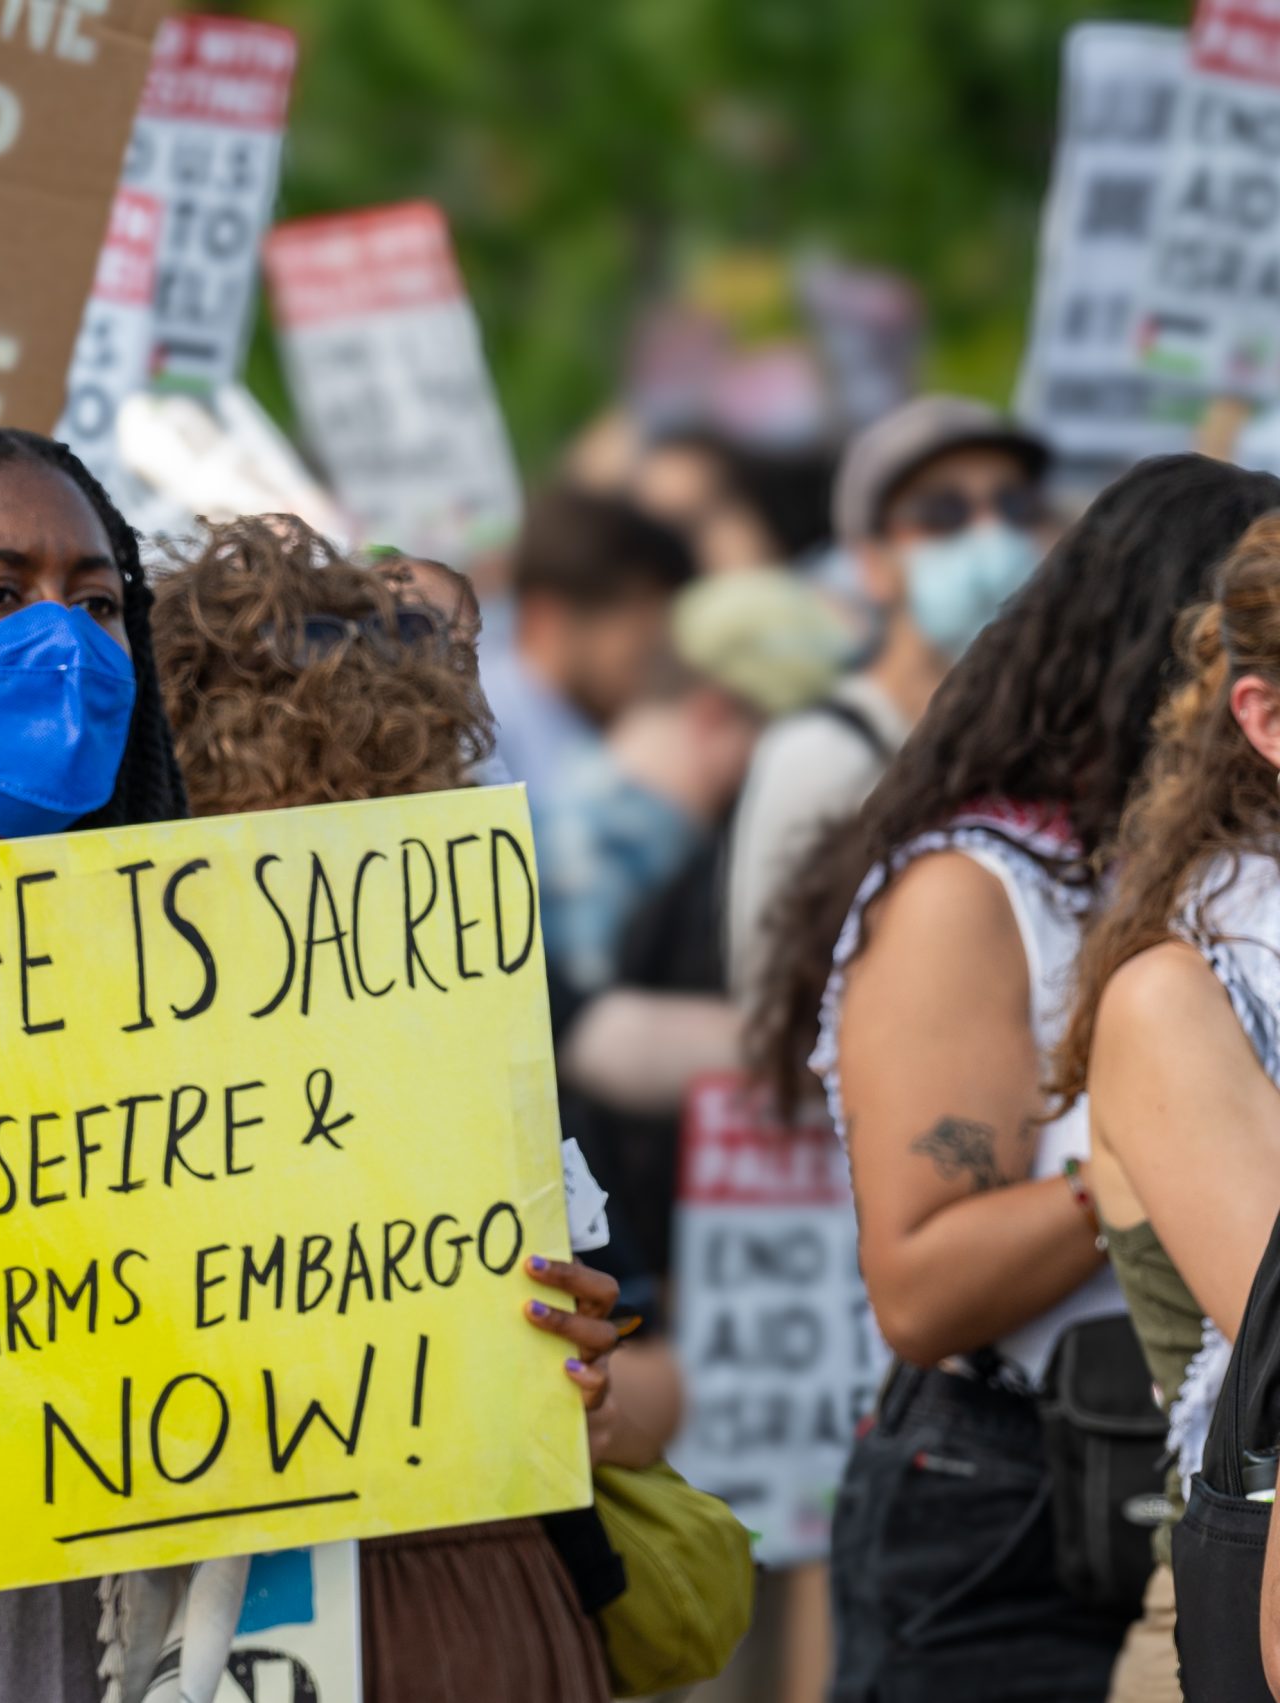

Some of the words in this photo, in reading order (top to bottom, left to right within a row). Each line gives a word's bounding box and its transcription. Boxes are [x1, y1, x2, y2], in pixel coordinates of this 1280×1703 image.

[117, 858, 218, 1032] IS
[251, 827, 537, 1019] SACRED
[300, 1068, 355, 1151] &
[194, 1202, 523, 1329] EMBARGO
